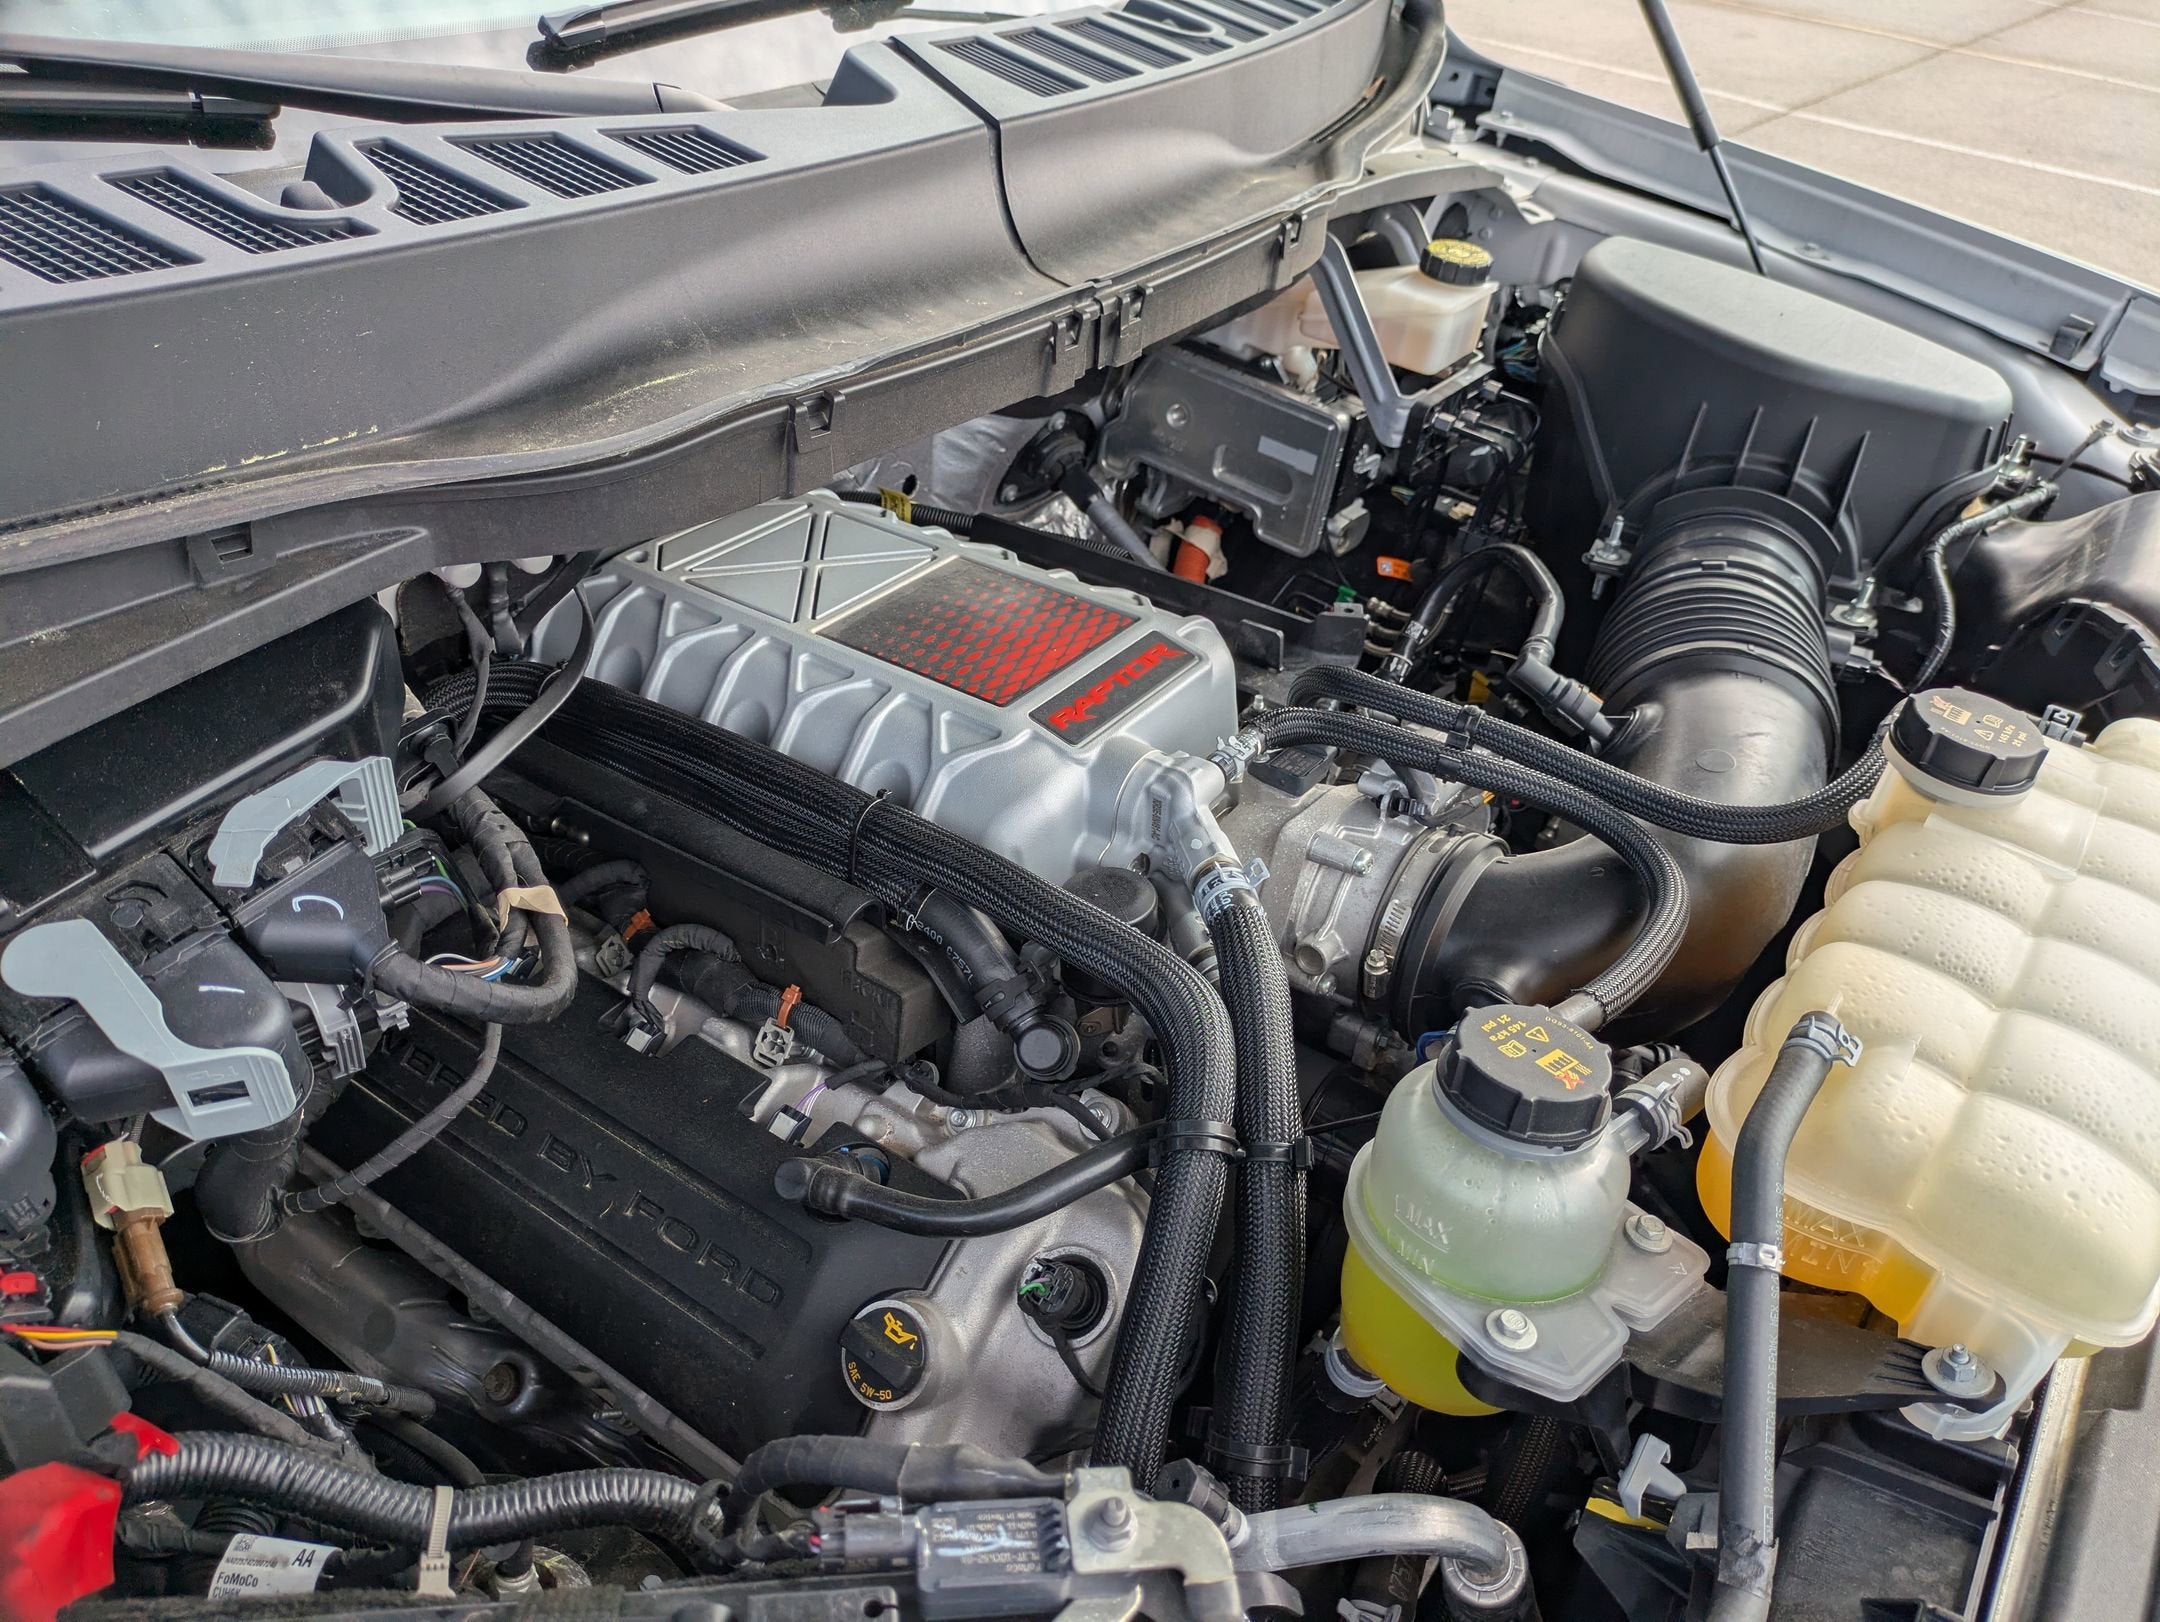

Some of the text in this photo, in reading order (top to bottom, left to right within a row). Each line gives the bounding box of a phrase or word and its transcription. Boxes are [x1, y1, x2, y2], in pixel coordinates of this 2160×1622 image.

[1048, 642, 1188, 730] RAPTOR
[1480, 1013, 1511, 1033] 21 psi
[1489, 1021, 1527, 1042] 145 kPa
[536, 1132, 618, 1190] BY
[623, 1190, 785, 1307] FORD
[848, 1361, 892, 1400] SAE 5W-50
[291, 1548, 316, 1568] AA
[216, 1571, 259, 1588] FoMoCo
